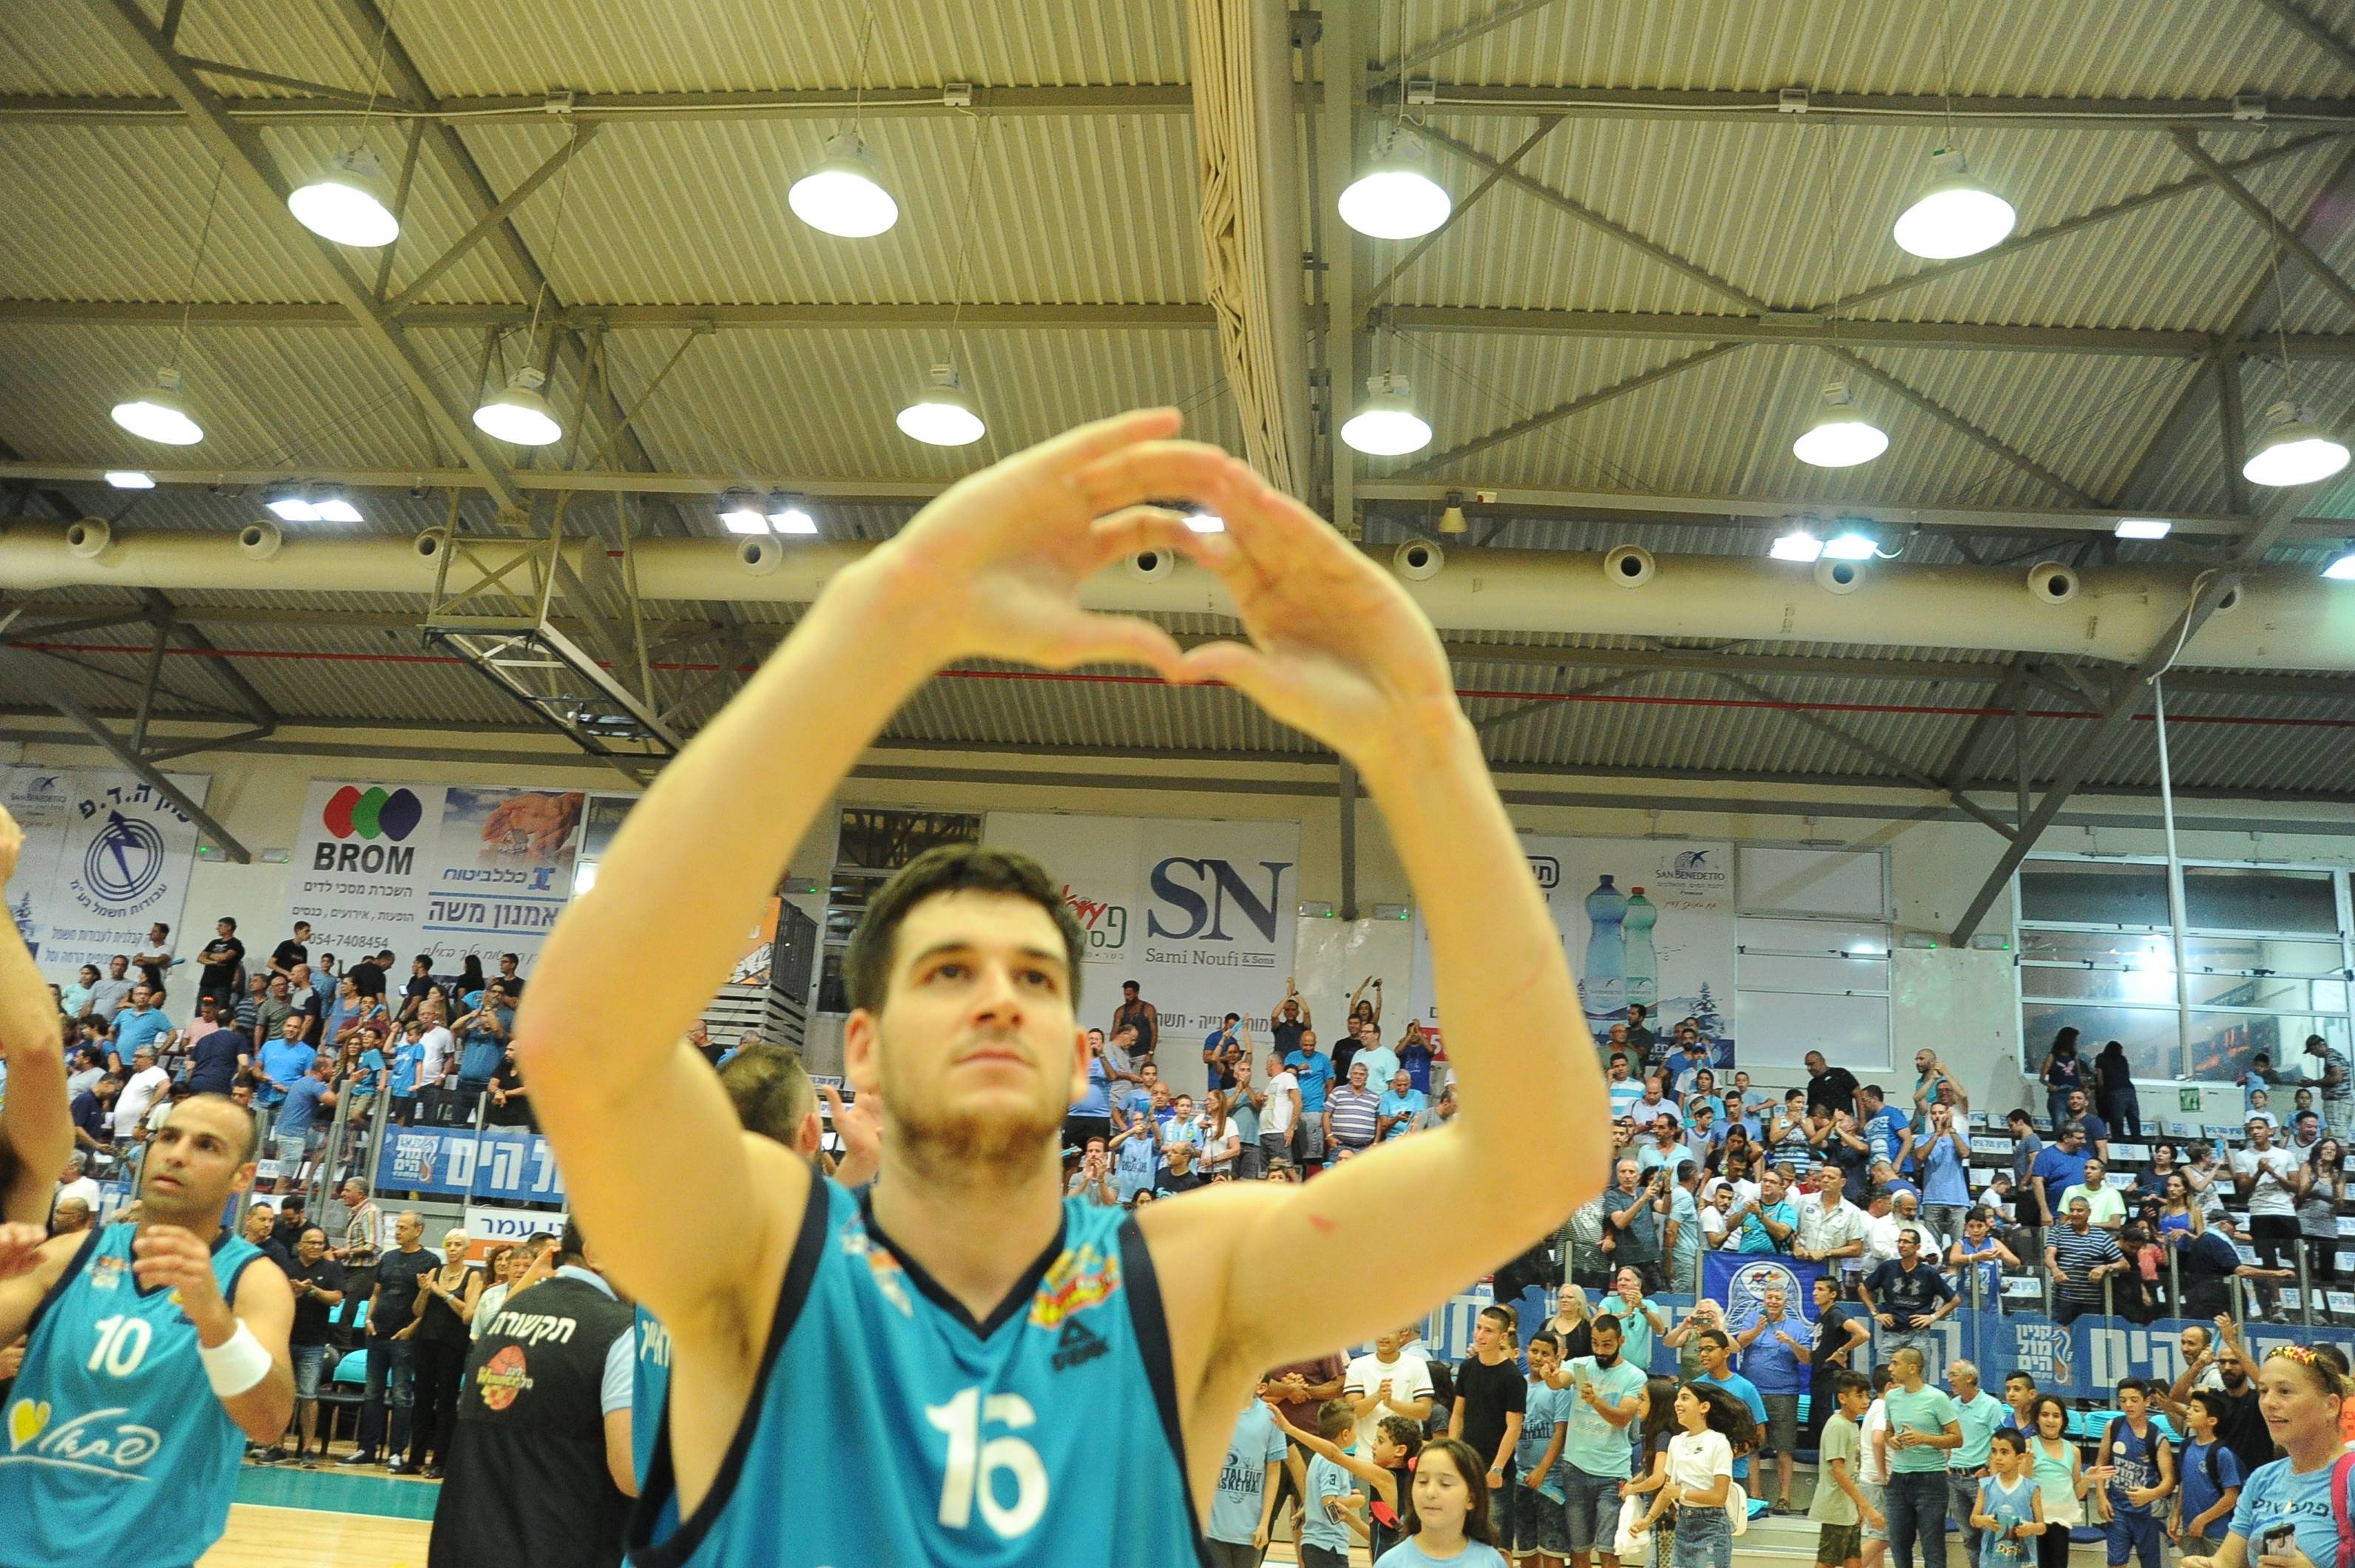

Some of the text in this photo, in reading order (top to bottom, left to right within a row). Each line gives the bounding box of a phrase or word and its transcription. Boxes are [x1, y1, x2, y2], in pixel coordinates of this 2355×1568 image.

[314, 842, 415, 876] BROM
[304, 879, 413, 897] השכרת מסכי לדים
[92, 902, 126, 917] חשמל
[130, 884, 168, 915] עבודות
[1147, 856, 1294, 944] SN
[428, 902, 560, 928] אמנון משה
[308, 933, 389, 949] 054-7408454
[1146, 947, 1187, 964] Sami
[1192, 950, 1239, 967] Noufi
[1252, 956, 1274, 964] Sons
[445, 1137, 524, 1190] הים
[481, 1218, 535, 1238] עמר
[487, 1311, 577, 1347] תקשורת
[2016, 1325, 2052, 1345] קניון
[87, 1314, 152, 1377] 10
[2019, 1339, 2052, 1356] מול
[2018, 1355, 2052, 1371] הים
[925, 1385, 1050, 1539] 16
[1329, 1473, 1337, 1486] 3
